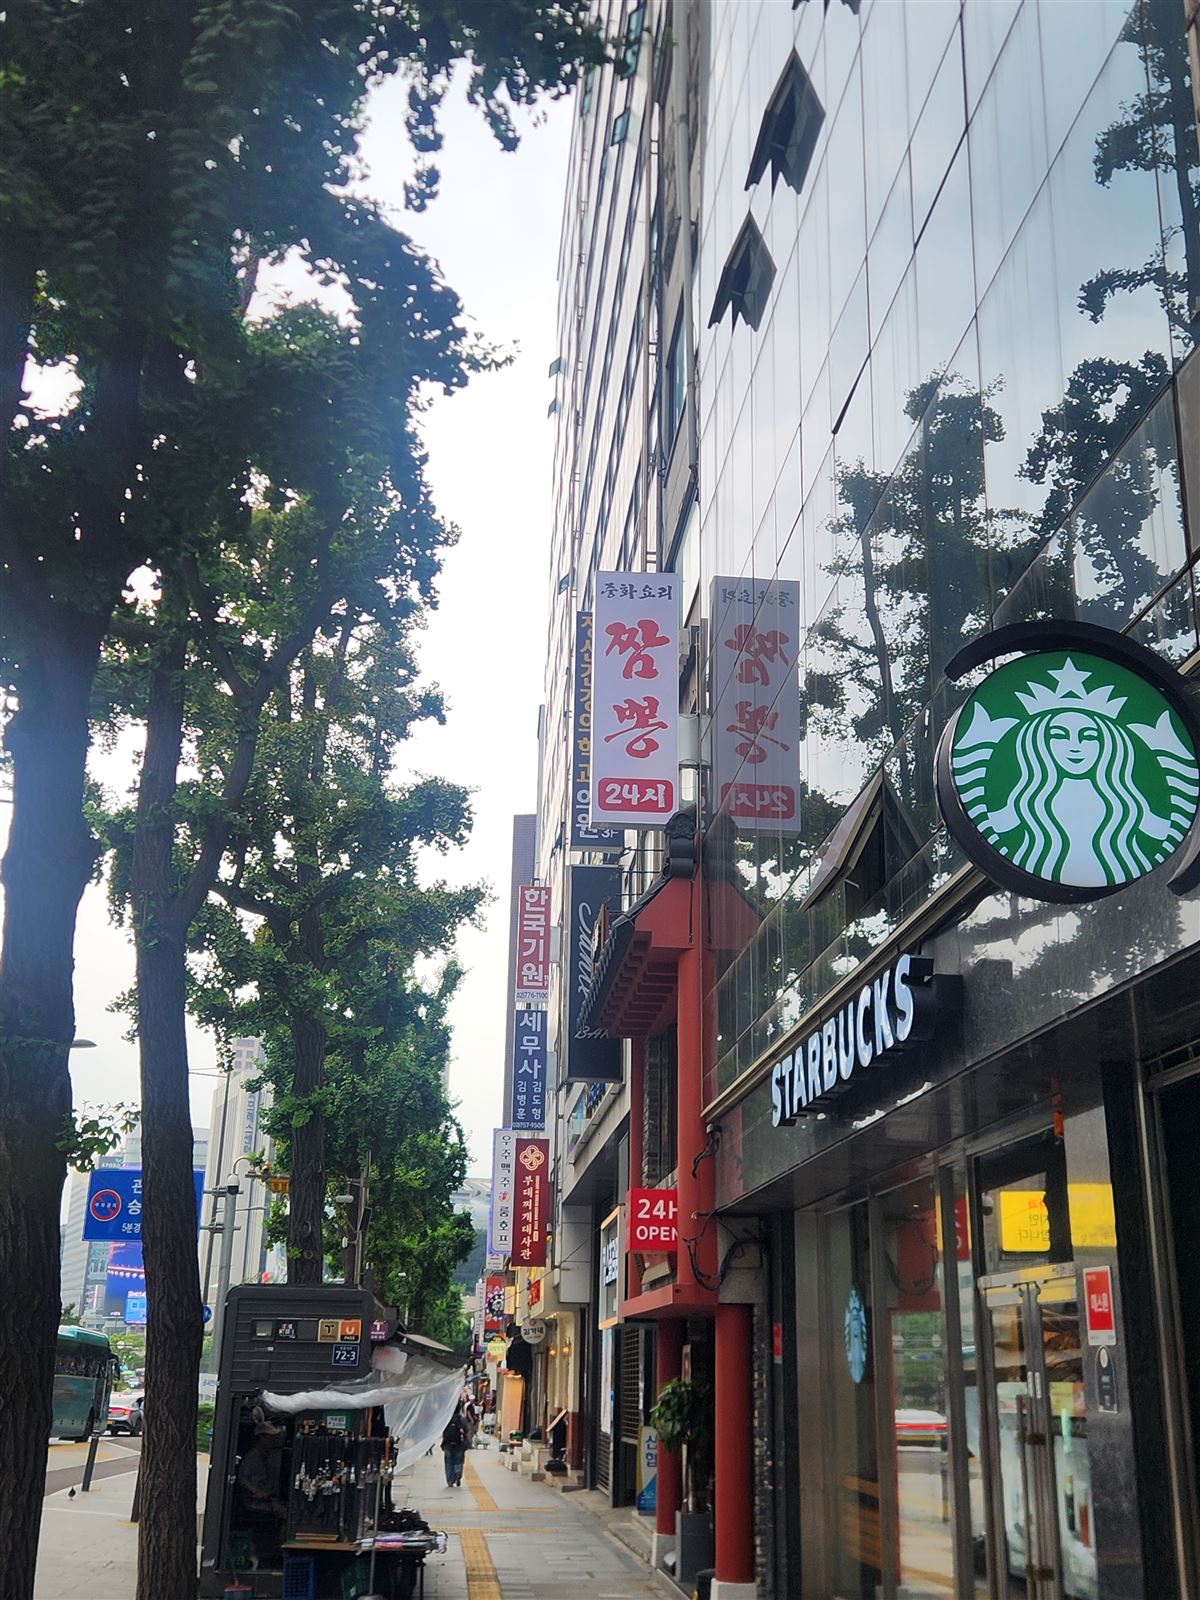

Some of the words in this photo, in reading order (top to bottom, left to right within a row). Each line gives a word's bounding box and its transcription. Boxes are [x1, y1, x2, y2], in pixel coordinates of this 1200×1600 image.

[601, 583, 673, 600] 중화요리
[604, 619, 671, 759] 짬뽕
[604, 783, 666, 808] 24시
[521, 888, 549, 986] 한국기원
[518, 1012, 542, 1079] 세무사
[771, 953, 914, 1128] STARBUCKS
[516, 1080, 527, 1120] 김병훈
[532, 1080, 542, 1120] 김도형
[500, 1135, 511, 1187] 우주맥주
